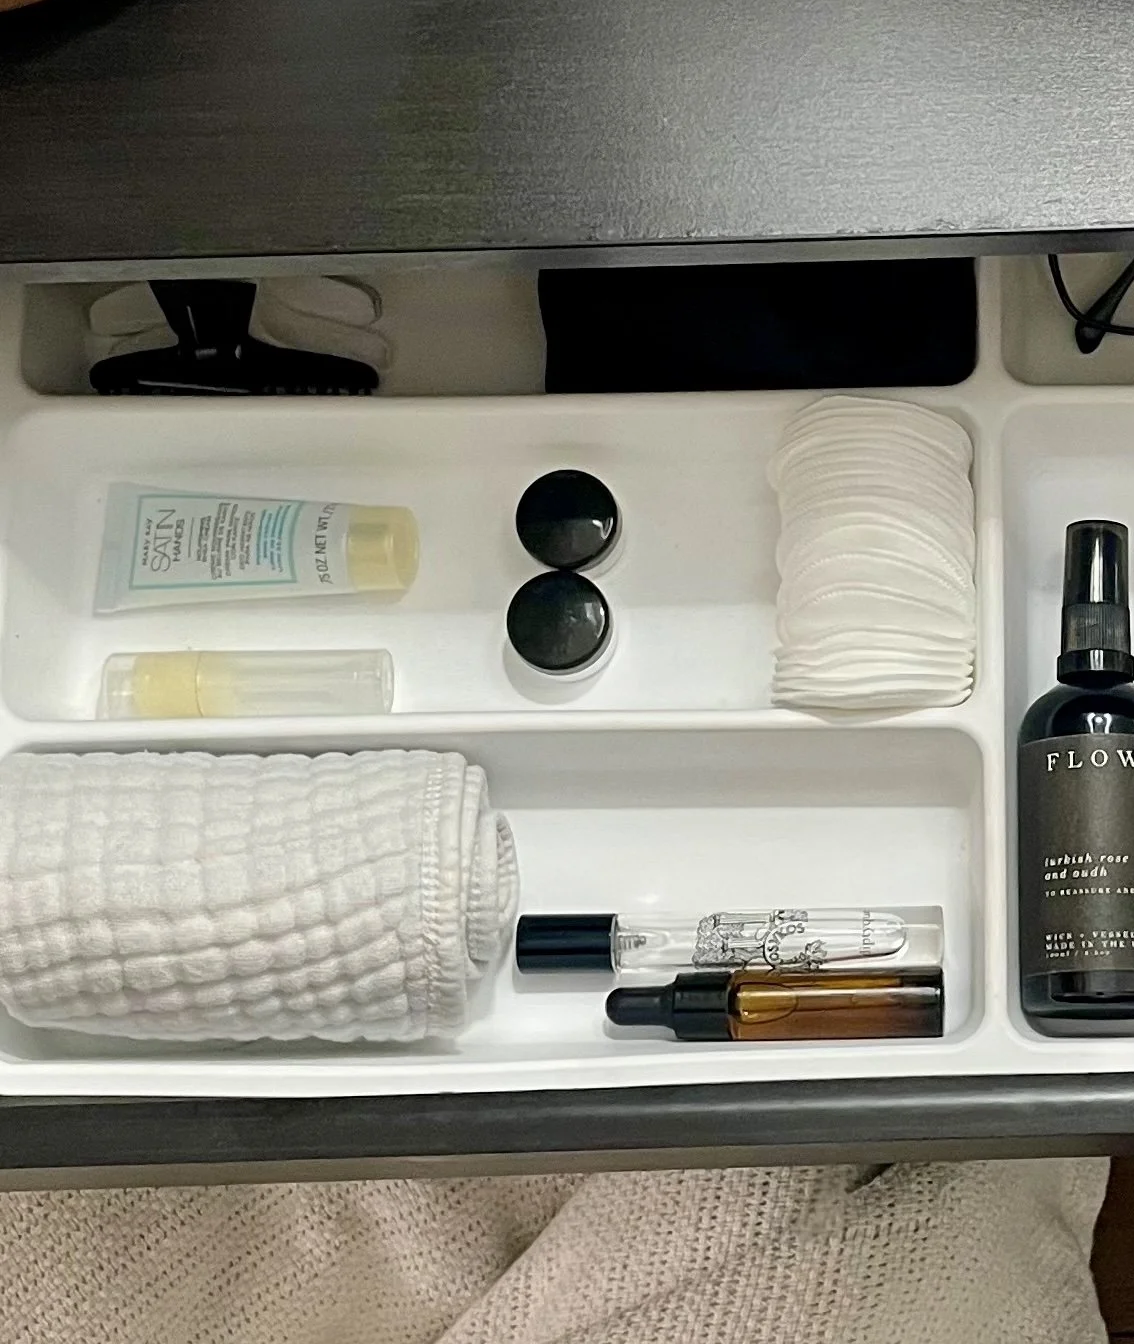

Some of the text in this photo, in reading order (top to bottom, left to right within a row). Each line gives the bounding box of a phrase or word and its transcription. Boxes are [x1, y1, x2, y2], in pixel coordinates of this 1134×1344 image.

[150, 508, 176, 572] SATIN
[172, 518, 185, 562] HANDS
[314, 535, 327, 555] NET
[316, 556, 329, 573] OZ
[1100, 855, 1129, 864] rose
[1044, 865, 1108, 881] and oudh
[1045, 941, 1076, 951] MADE
[1101, 940, 1125, 949] THE
